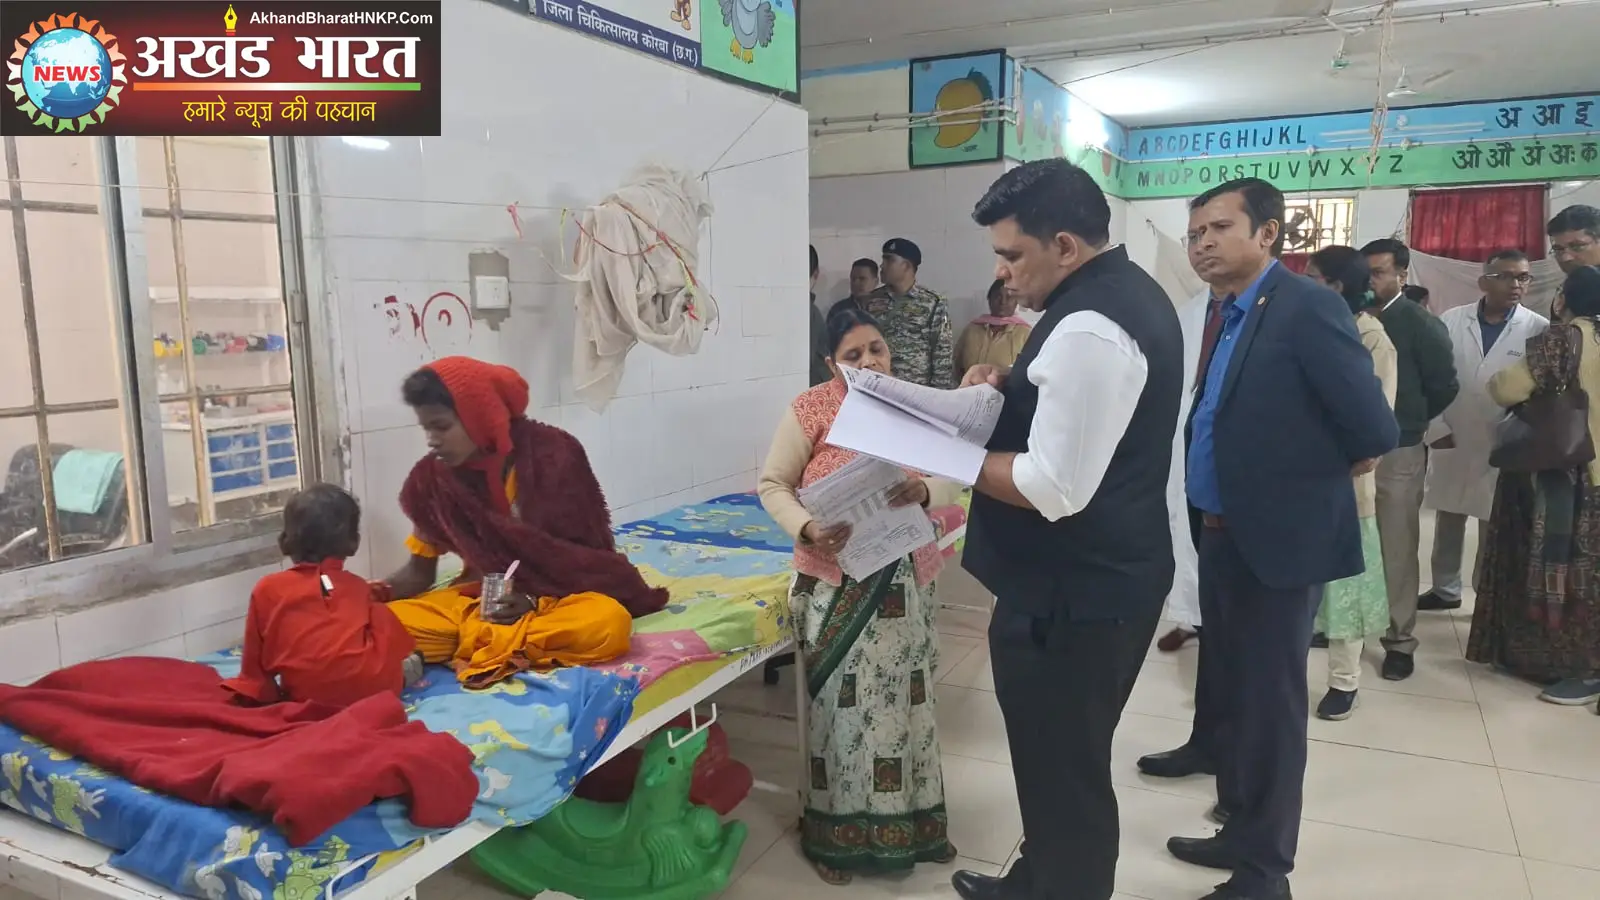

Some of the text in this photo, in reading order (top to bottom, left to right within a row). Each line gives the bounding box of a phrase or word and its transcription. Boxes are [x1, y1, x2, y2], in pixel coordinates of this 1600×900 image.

[577, 5, 639, 44] चिकित्सालय
[642, 30, 669, 54] कोरबा
[672, 41, 699, 67] (छ.ग.)
